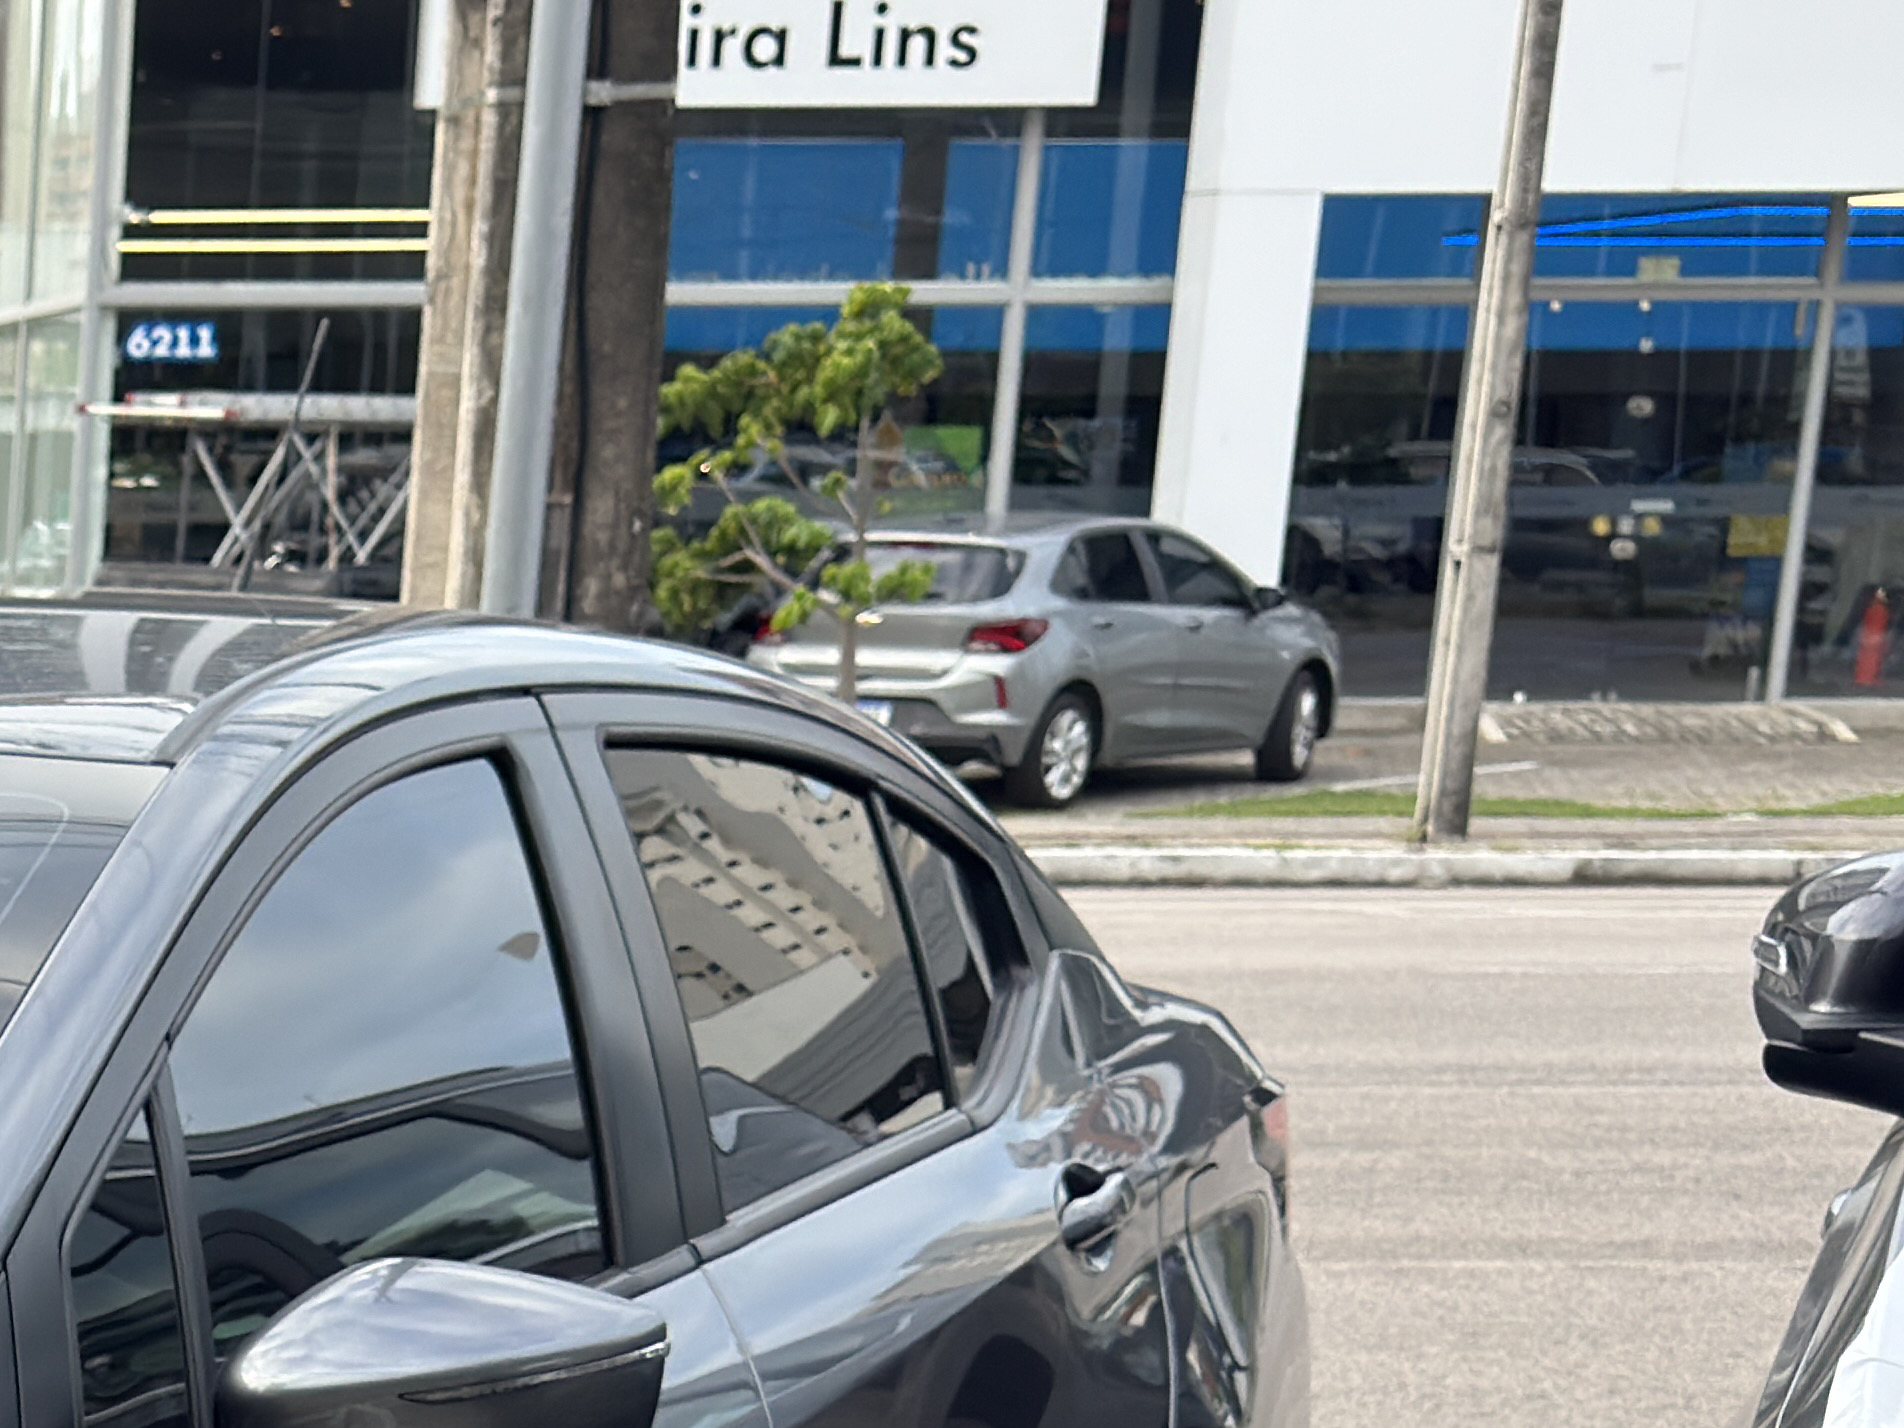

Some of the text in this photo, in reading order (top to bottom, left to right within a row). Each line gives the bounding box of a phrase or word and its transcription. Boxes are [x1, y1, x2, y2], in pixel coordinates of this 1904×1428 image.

[686, 0, 980, 69] ira Lins
[126, 322, 218, 358] 6211
